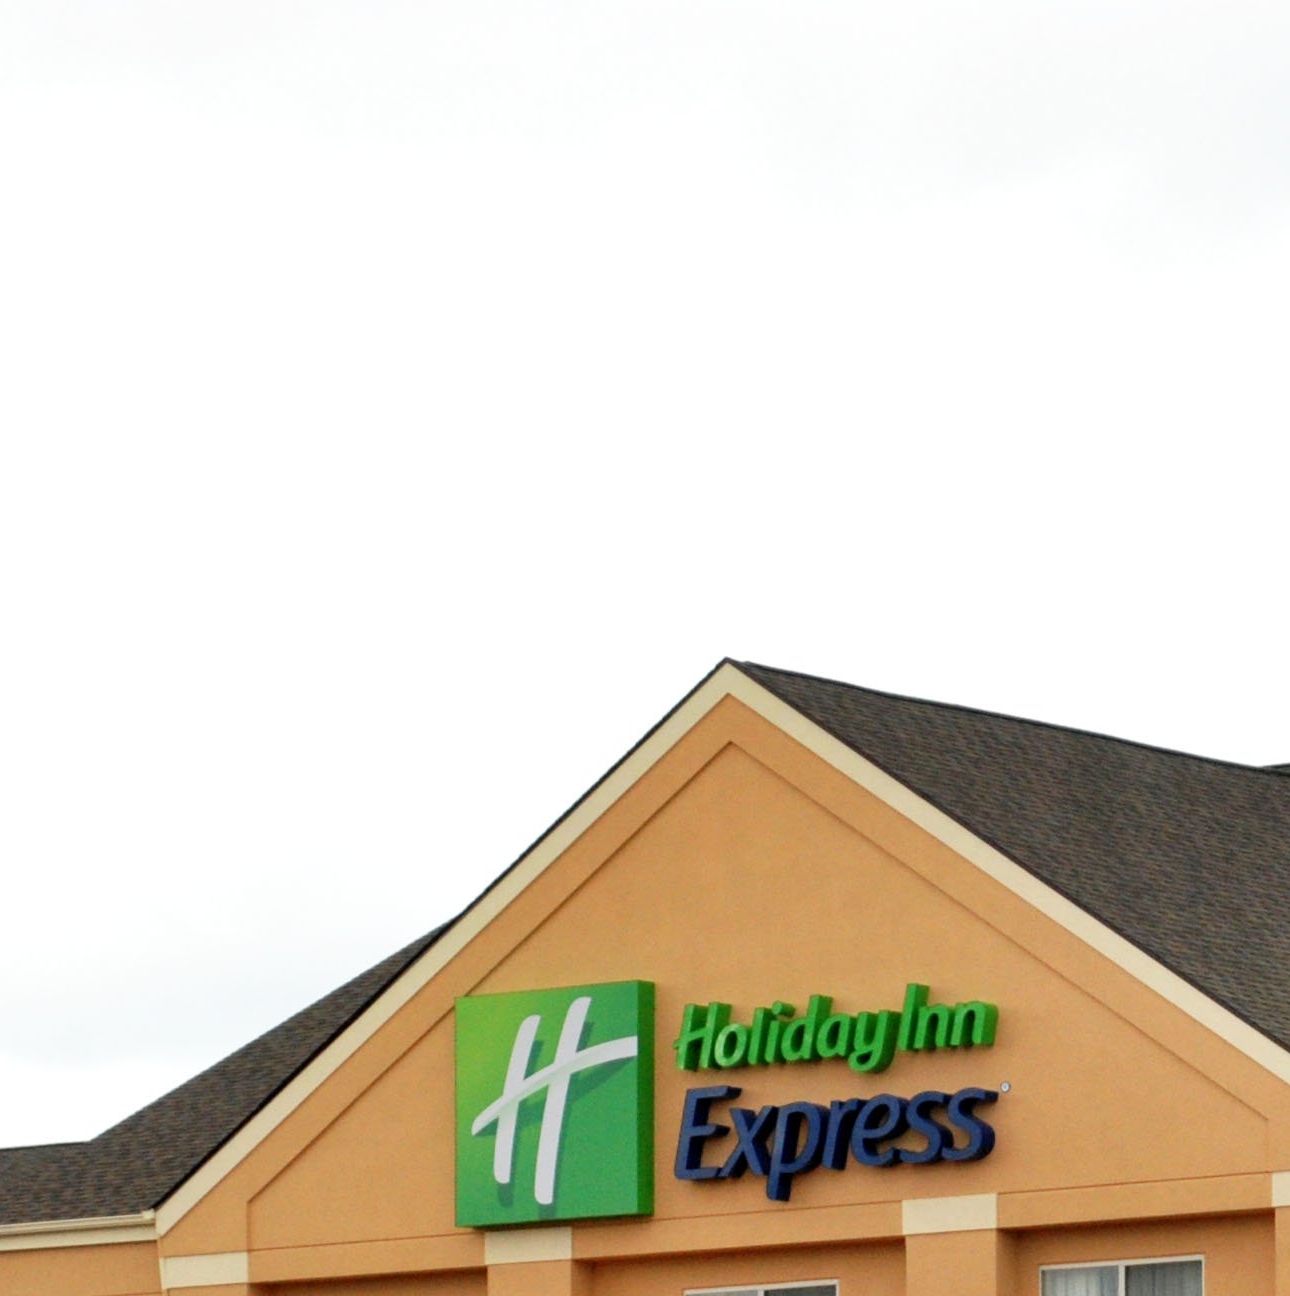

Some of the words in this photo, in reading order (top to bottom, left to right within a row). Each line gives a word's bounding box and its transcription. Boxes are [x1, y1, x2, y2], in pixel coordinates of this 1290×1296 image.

[674, 993, 899, 1073] Holiday
[895, 983, 999, 1051] Inn
[673, 1084, 999, 1202] Express
